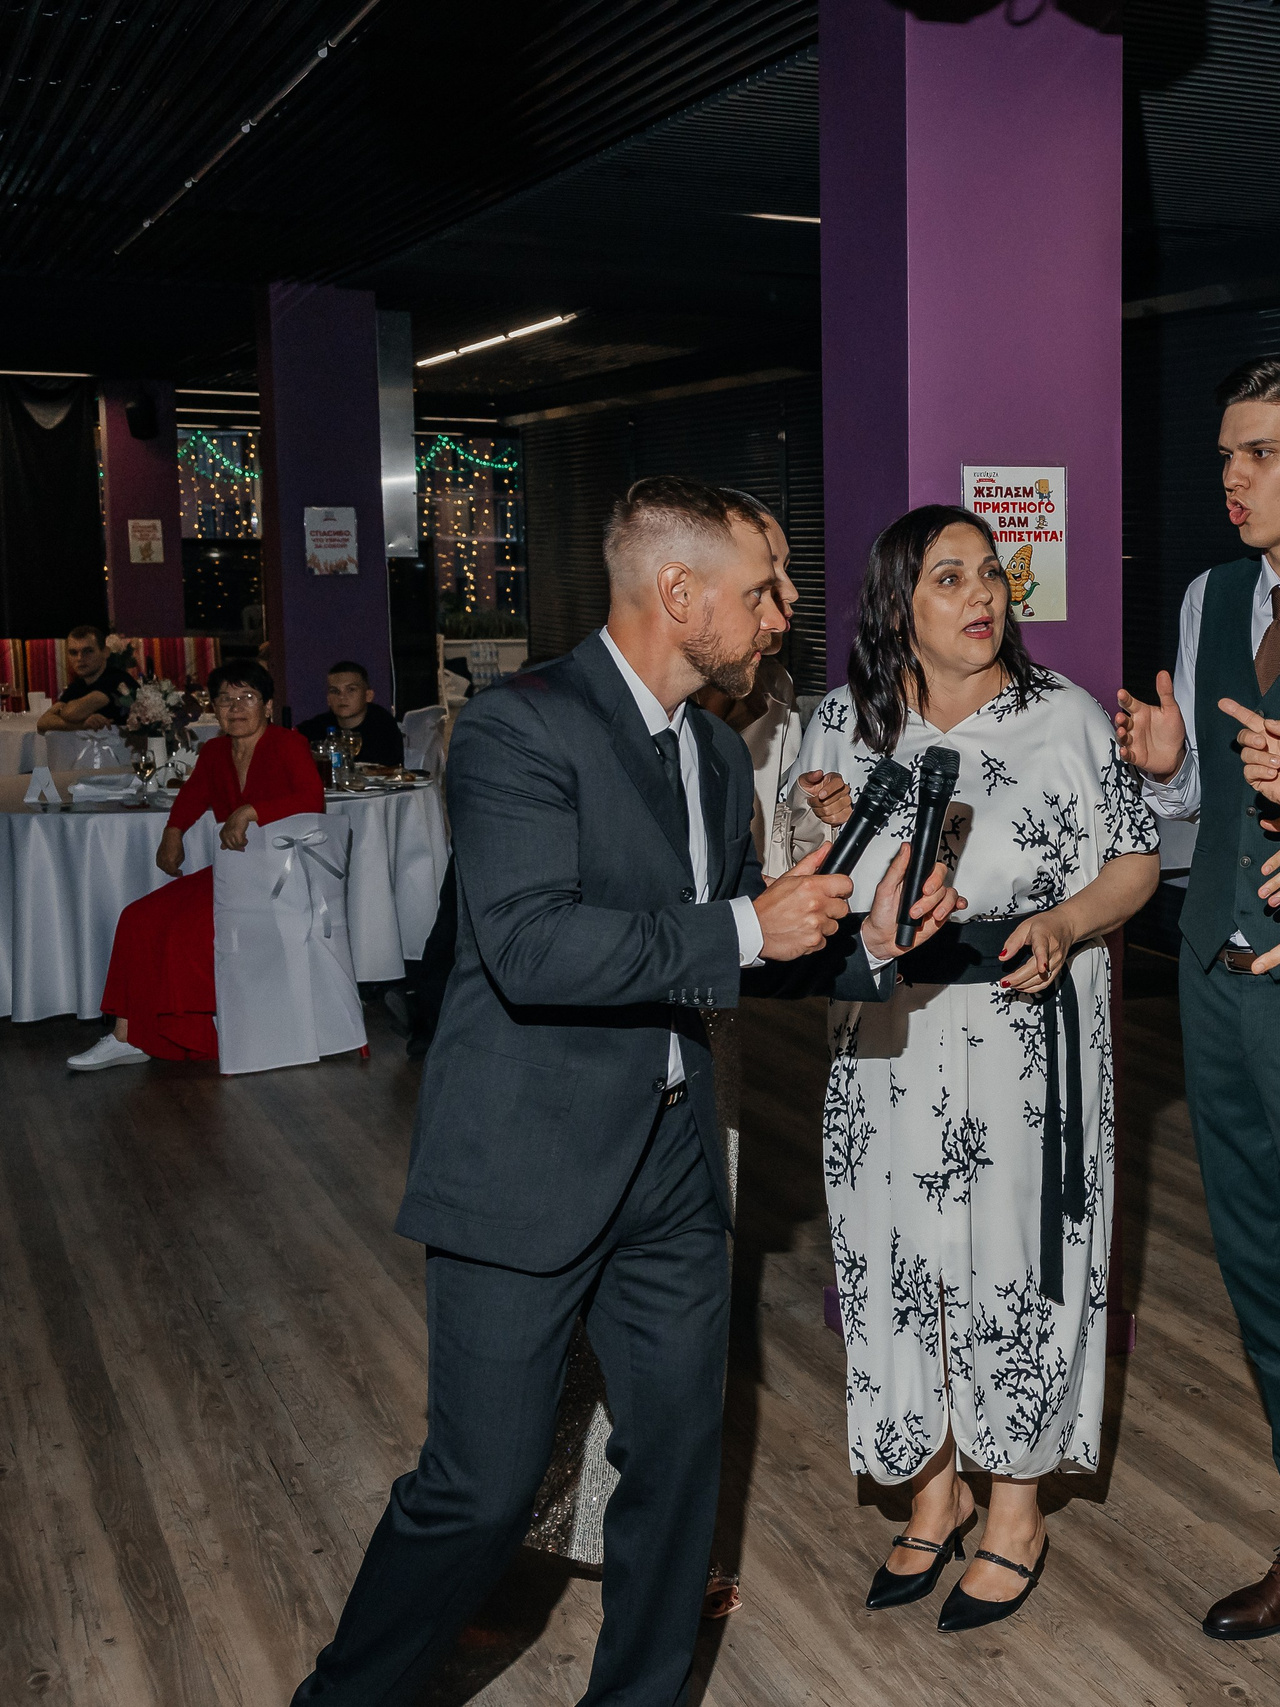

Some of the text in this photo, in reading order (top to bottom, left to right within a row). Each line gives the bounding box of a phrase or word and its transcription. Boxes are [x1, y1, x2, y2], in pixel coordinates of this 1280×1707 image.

[973, 486, 1034, 498] ЖЕЛАЕМ
[973, 501, 1055, 513] ПРИЯТНОГО
[998, 516, 1029, 527] ВАМ
